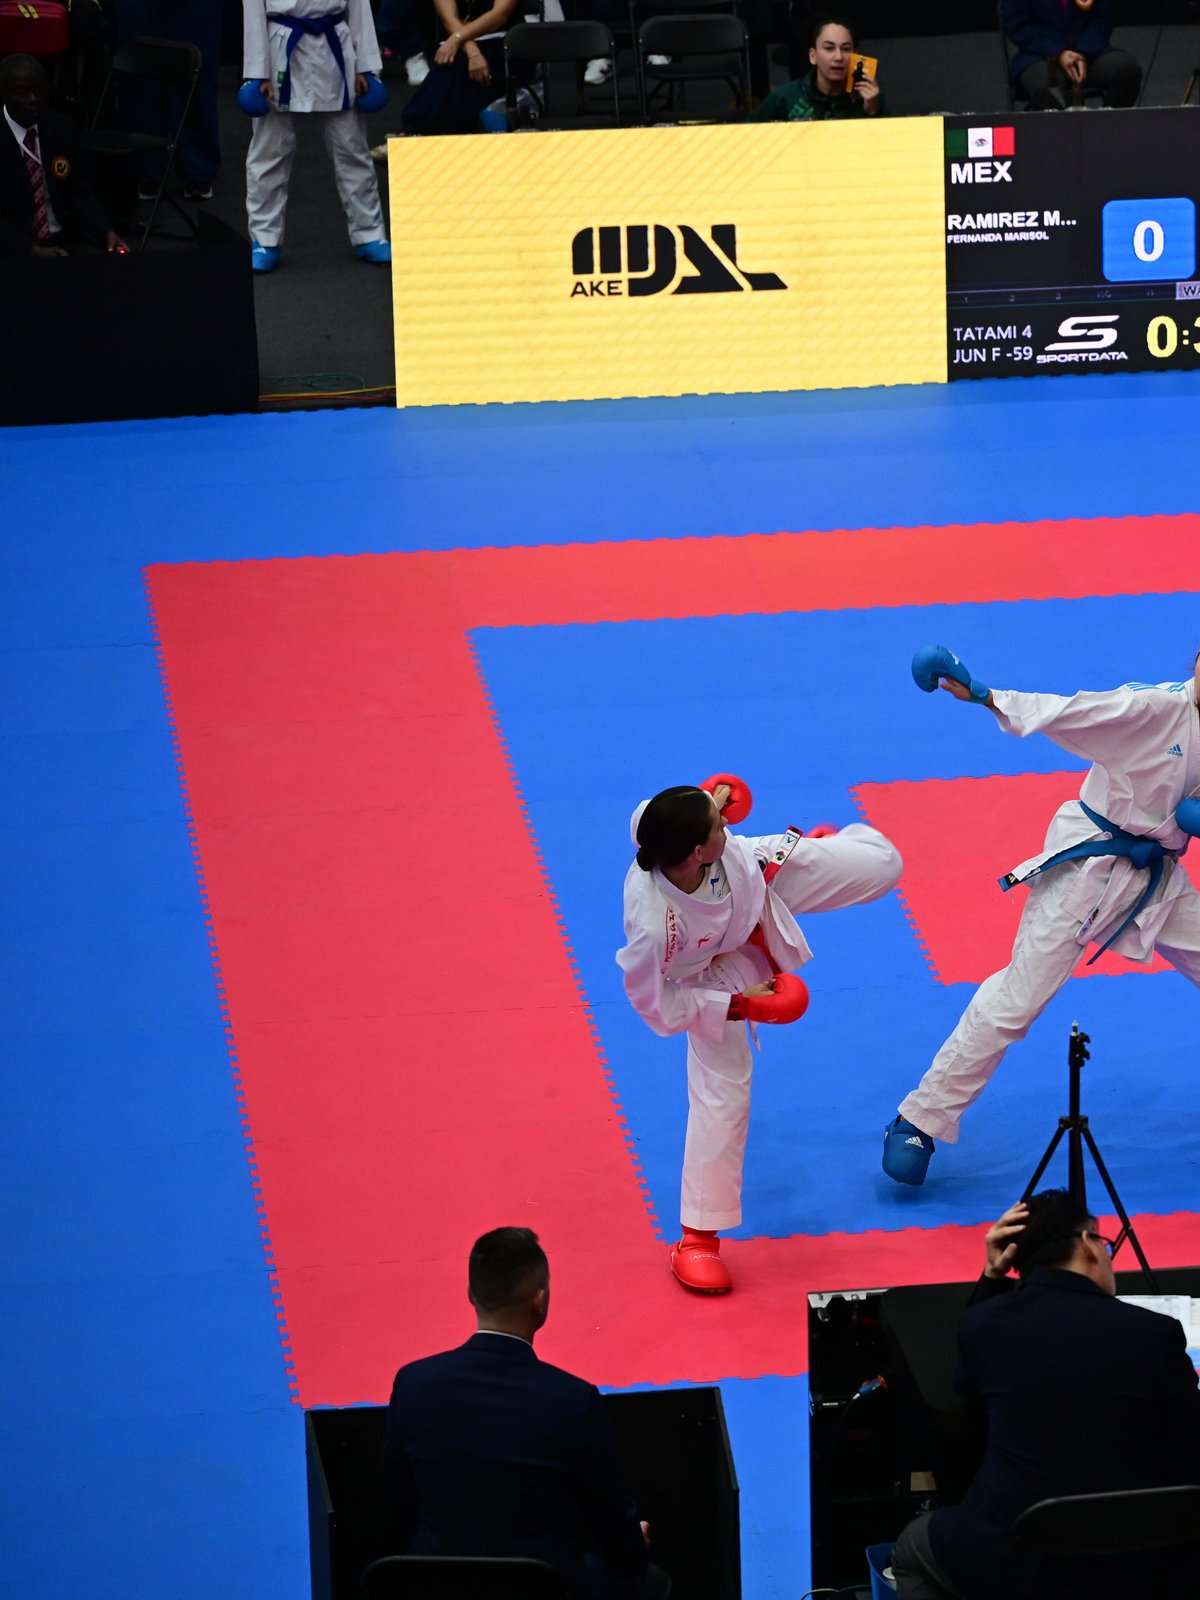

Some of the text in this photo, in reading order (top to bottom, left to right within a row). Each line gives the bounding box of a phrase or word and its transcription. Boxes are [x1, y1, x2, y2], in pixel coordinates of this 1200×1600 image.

[951, 161, 1012, 184] MEX
[947, 210, 1077, 230] RAMIREZ M...
[947, 231, 1050, 243] FERNANDA MARISOL
[1133, 220, 1165, 262] 0
[570, 280, 623, 297] AKE
[953, 325, 1033, 342] TATAMI 4
[953, 346, 1034, 364] JUN F -59
[1036, 351, 1129, 364] SPORTDATA
